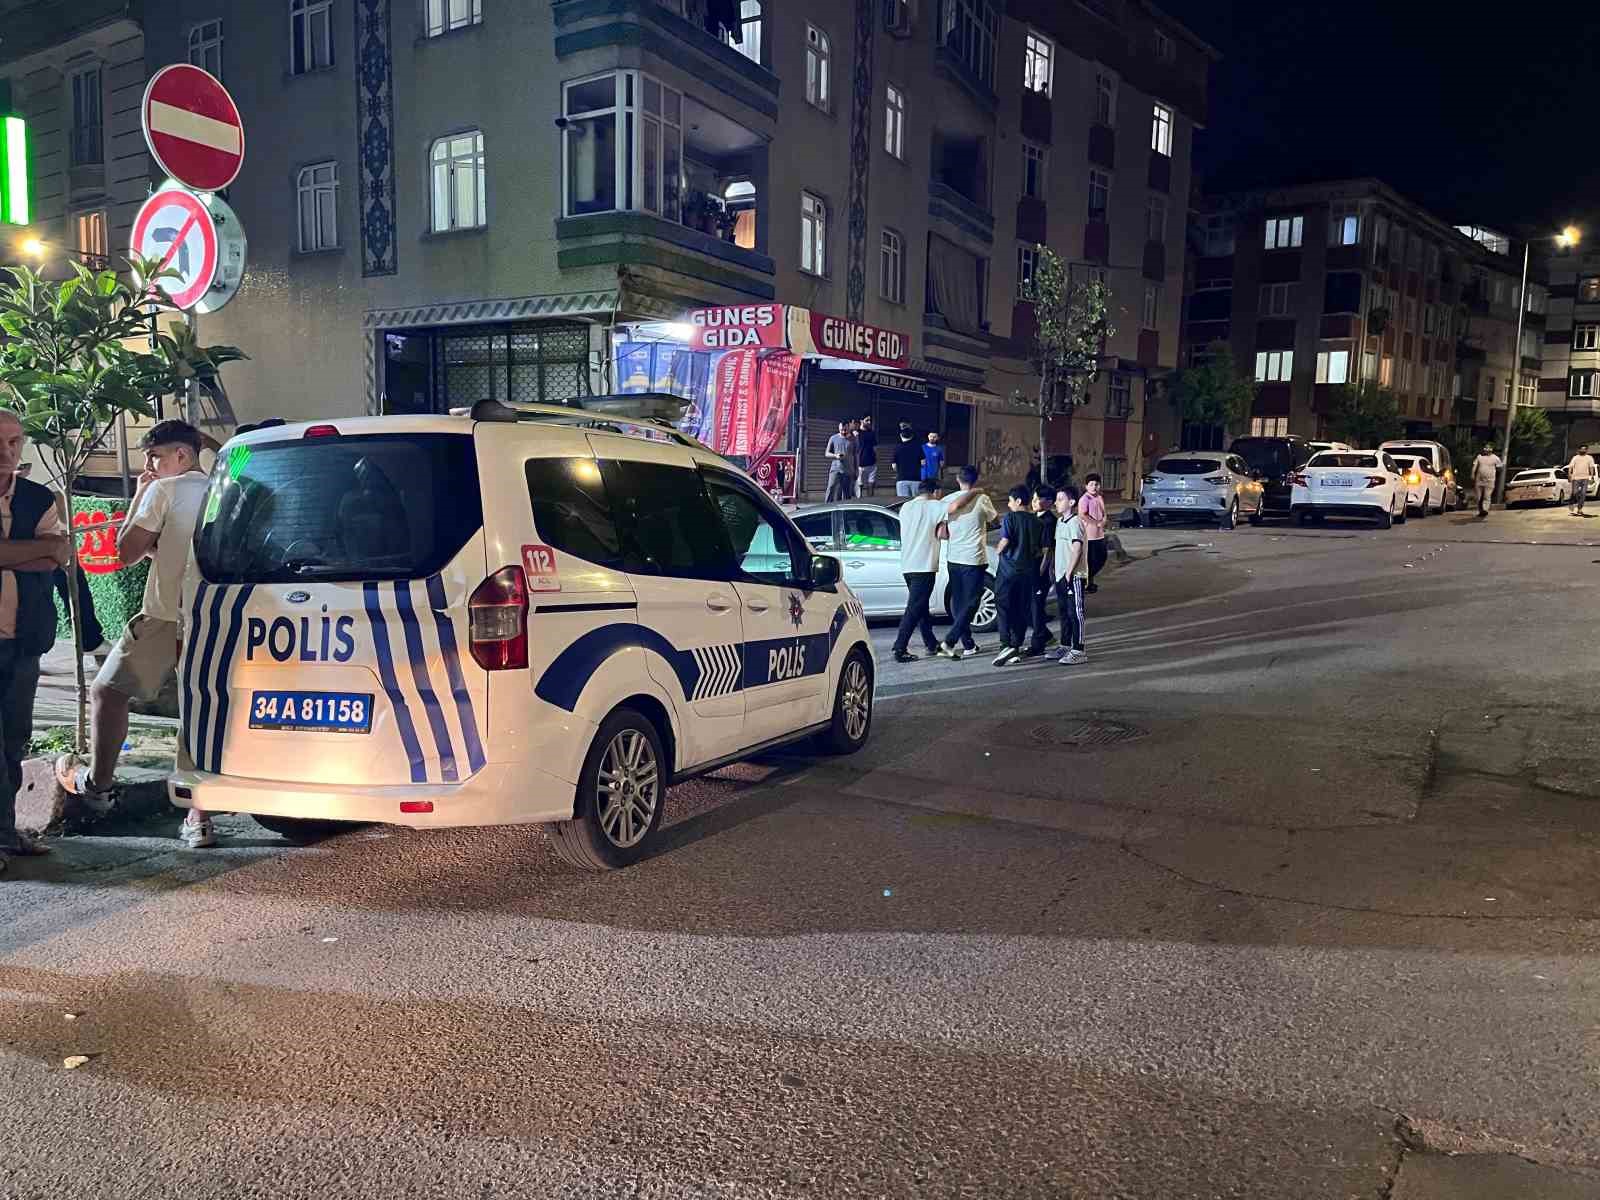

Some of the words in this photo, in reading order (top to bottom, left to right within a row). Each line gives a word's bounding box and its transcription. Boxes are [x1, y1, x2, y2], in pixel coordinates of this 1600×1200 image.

[703, 327, 761, 347] GIDA
[823, 318, 873, 359] GÜNEŞ
[526, 550, 553, 573] 112
[246, 602, 355, 663] POLİS
[768, 638, 806, 682] POLİS
[255, 697, 278, 719] 34
[281, 698, 296, 720] A
[301, 698, 364, 723] 81158
